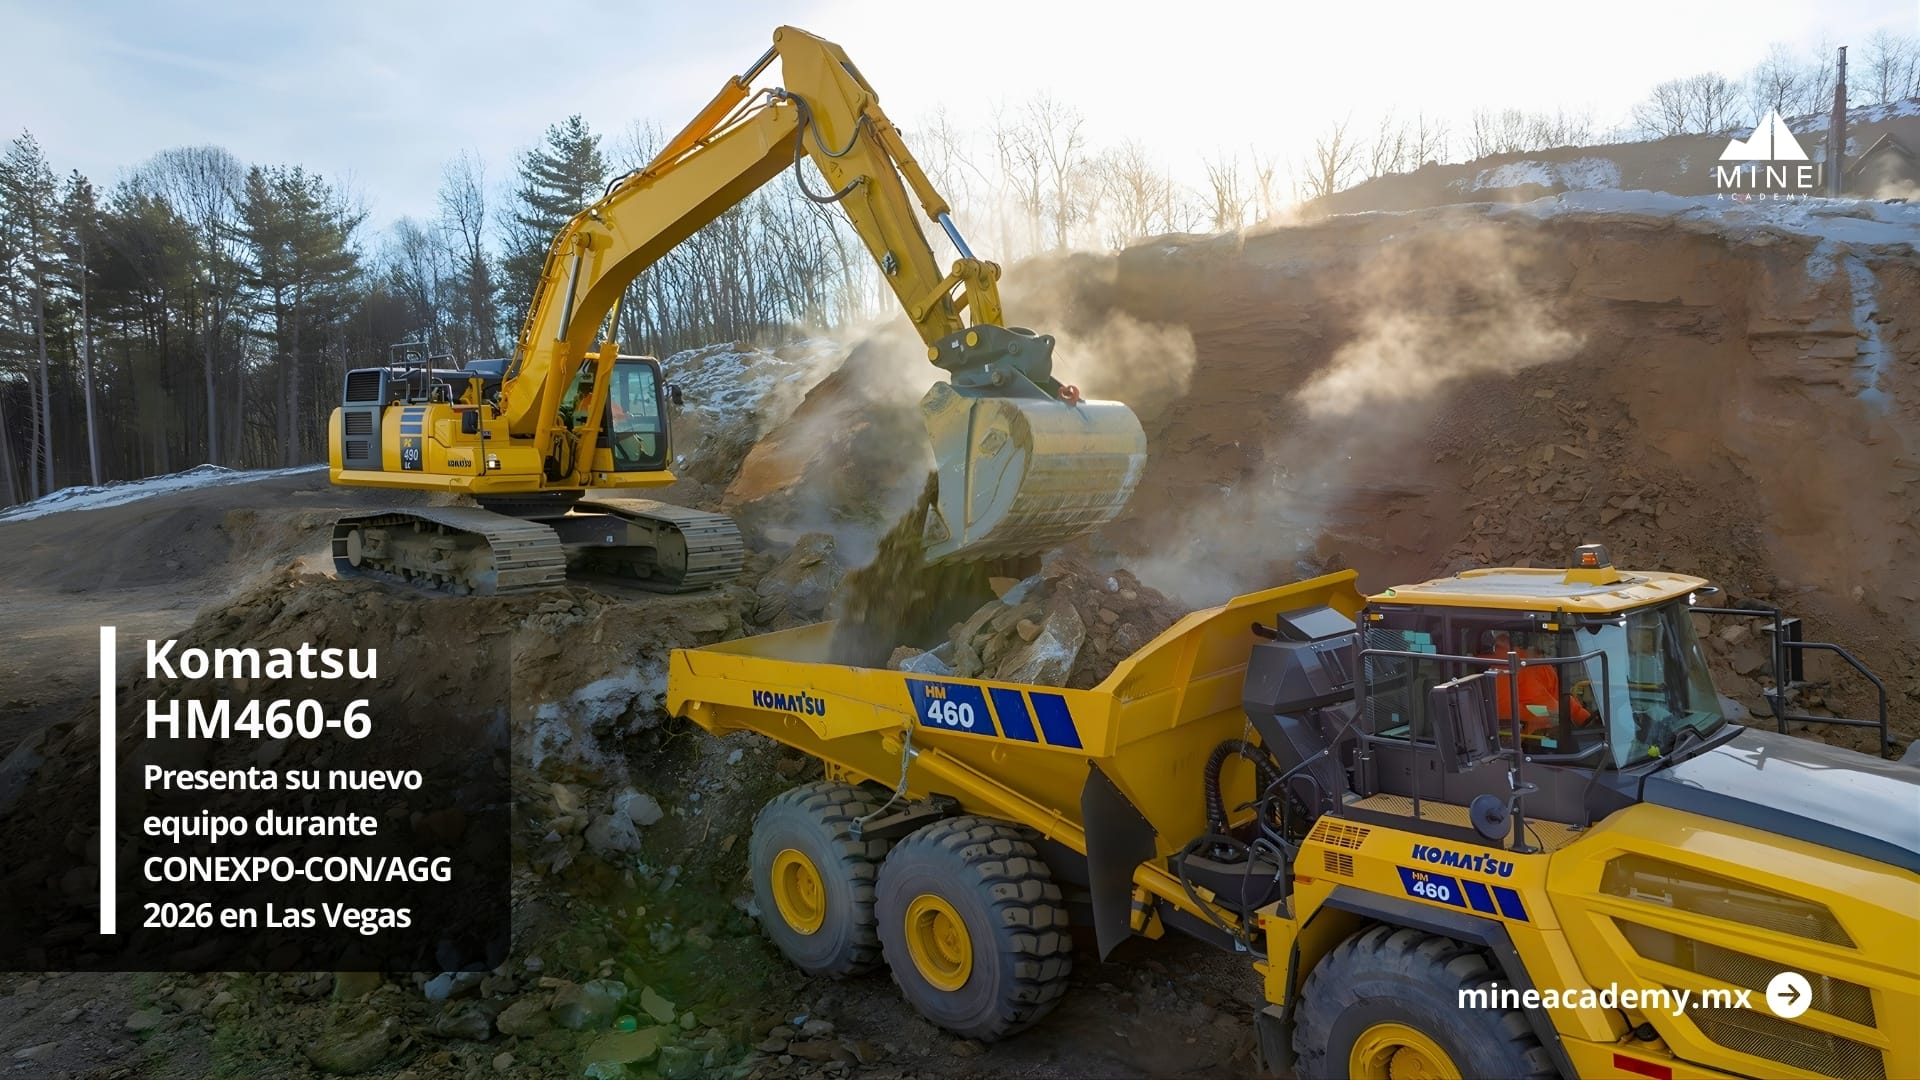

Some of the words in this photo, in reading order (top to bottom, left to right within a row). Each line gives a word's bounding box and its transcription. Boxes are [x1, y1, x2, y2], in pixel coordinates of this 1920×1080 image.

[404, 448, 419, 461] 490
[924, 685, 946, 700] HM
[752, 690, 826, 717] KOMATSU
[927, 699, 975, 729] 460
[1411, 844, 1514, 878] KOMATSU
[1412, 871, 1429, 882] HM
[1412, 881, 1450, 901] 460
